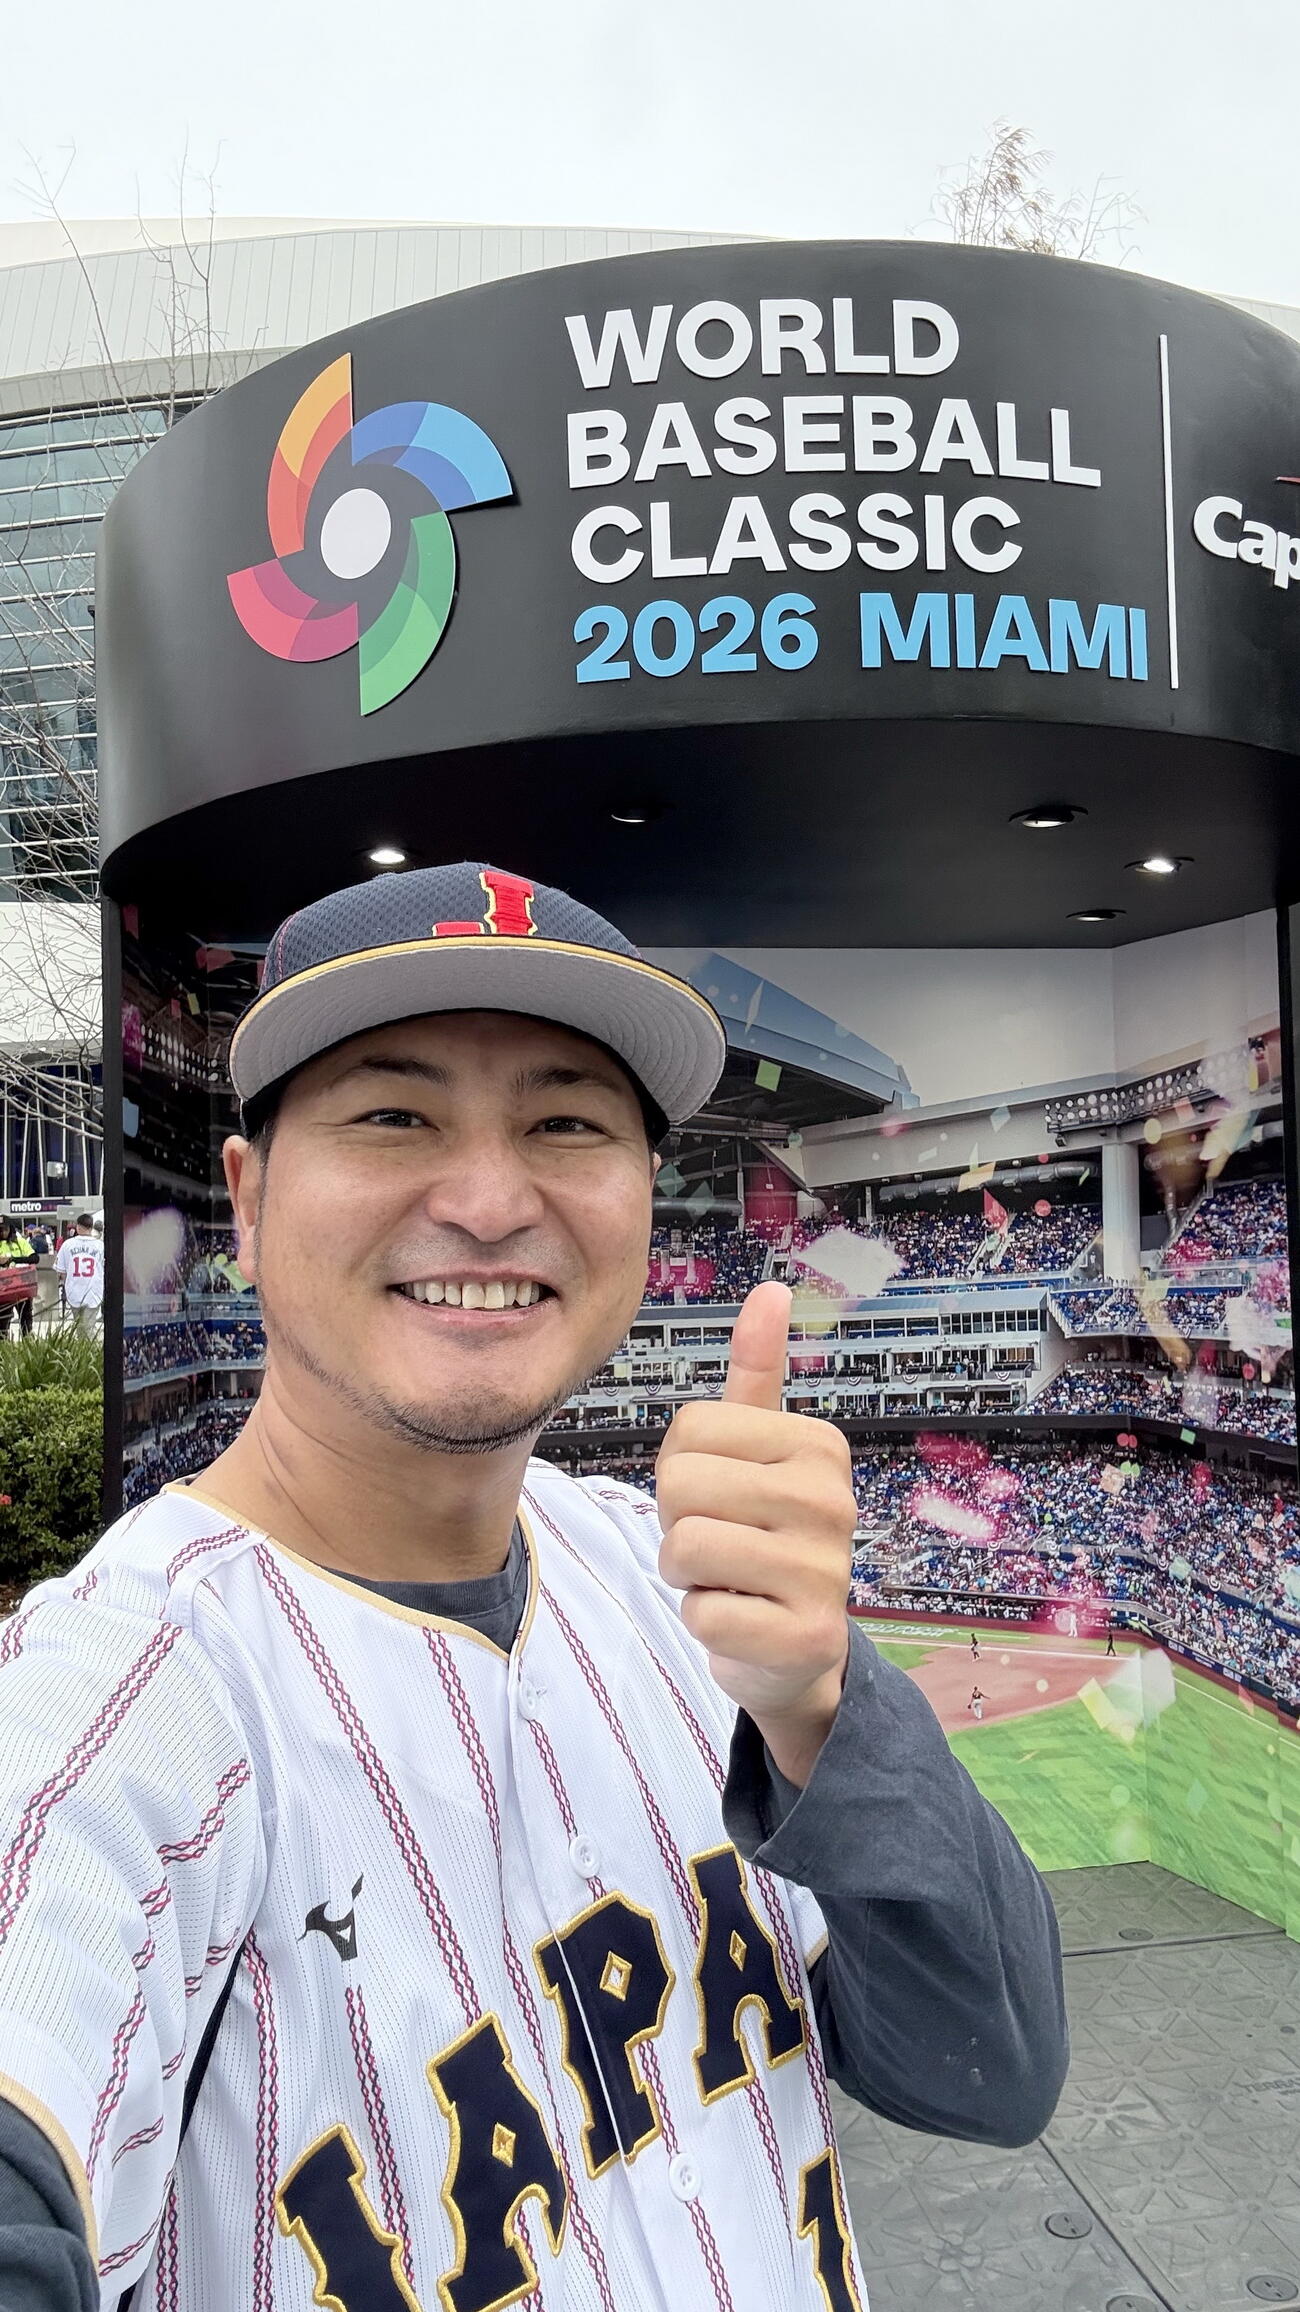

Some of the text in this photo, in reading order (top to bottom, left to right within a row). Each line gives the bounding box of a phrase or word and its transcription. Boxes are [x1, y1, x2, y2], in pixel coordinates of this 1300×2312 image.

[564, 297, 960, 389] WORLD
[567, 395, 1102, 489] BASEBALL
[570, 492, 1022, 584] CLASSIC
[573, 592, 1149, 684] 2026 MIAMI
[11, 1201, 42, 1212] metro
[72, 1256, 96, 1277] 13
